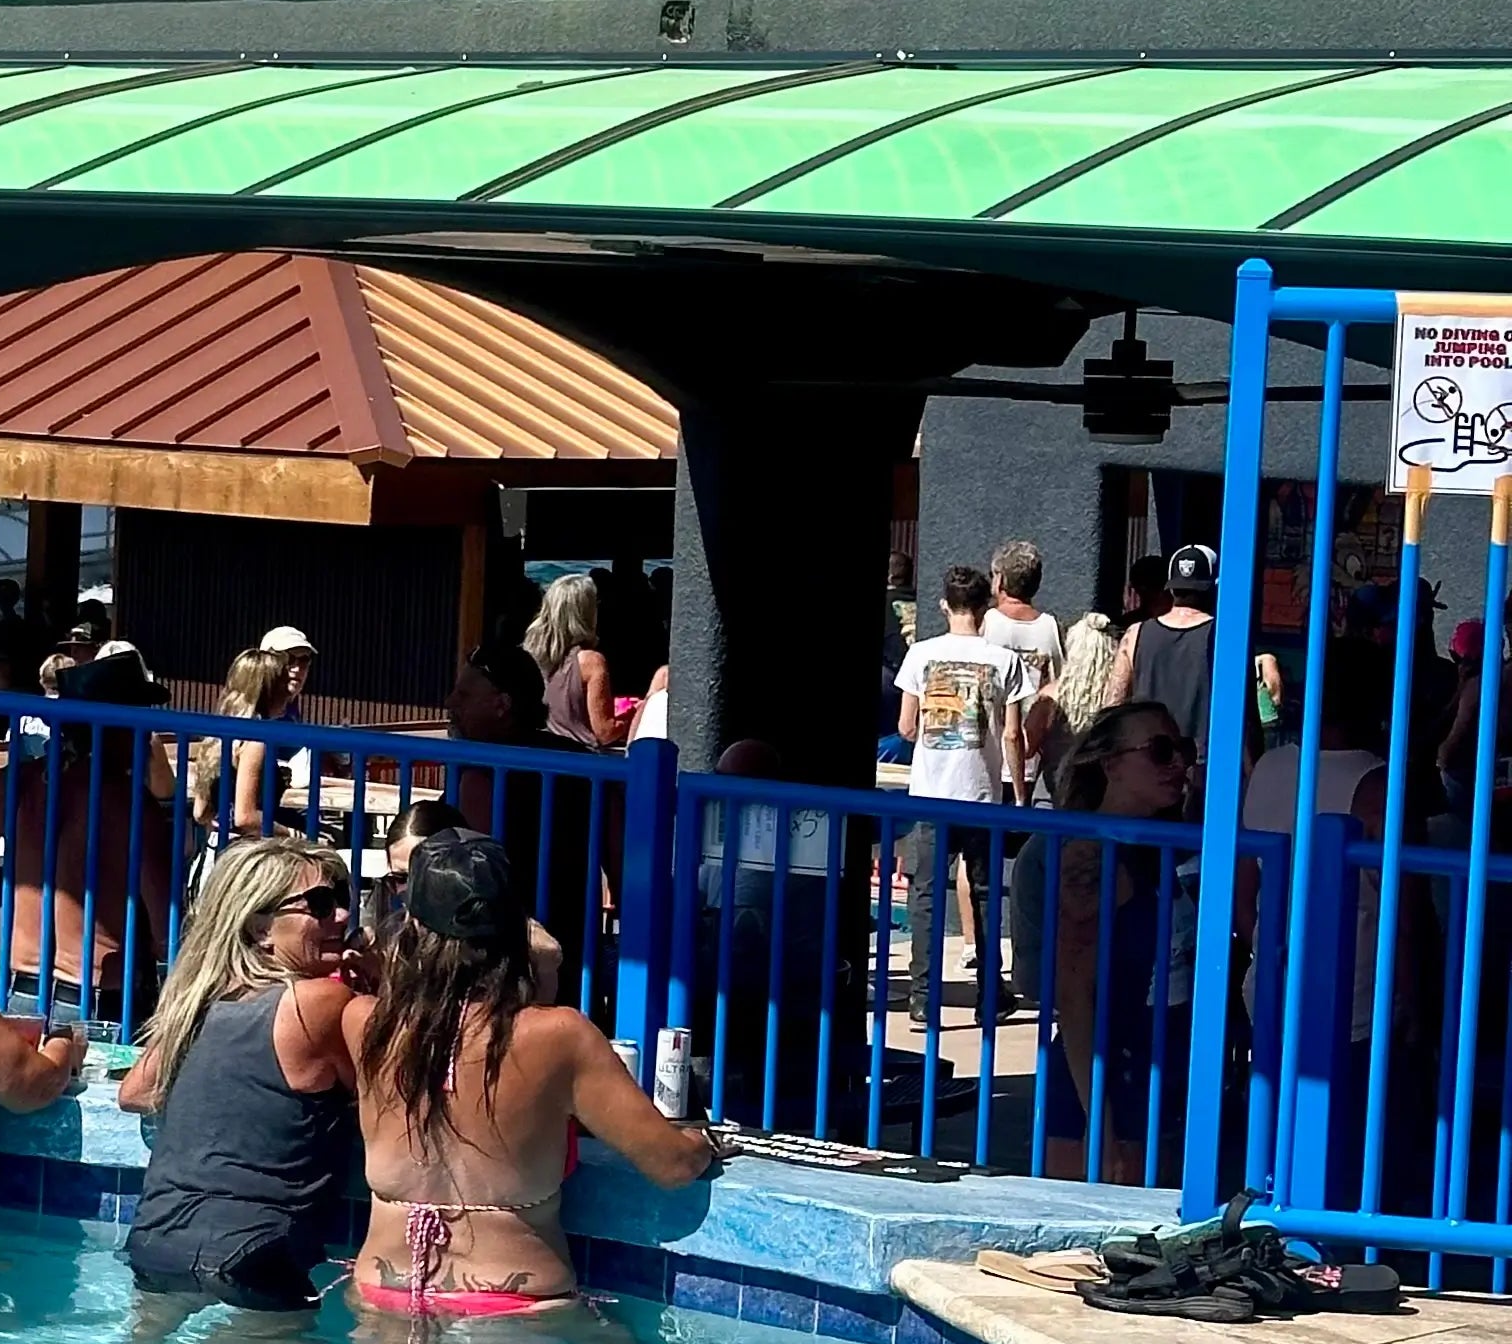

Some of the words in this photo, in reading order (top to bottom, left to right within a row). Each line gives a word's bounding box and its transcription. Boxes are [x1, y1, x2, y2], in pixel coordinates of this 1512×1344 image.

[1415, 327, 1438, 340] NO
[1442, 328, 1500, 341] DIVING
[1433, 342, 1507, 355] JUMPING
[1425, 355, 1465, 367] INTO
[1469, 356, 1512, 369] POOL
